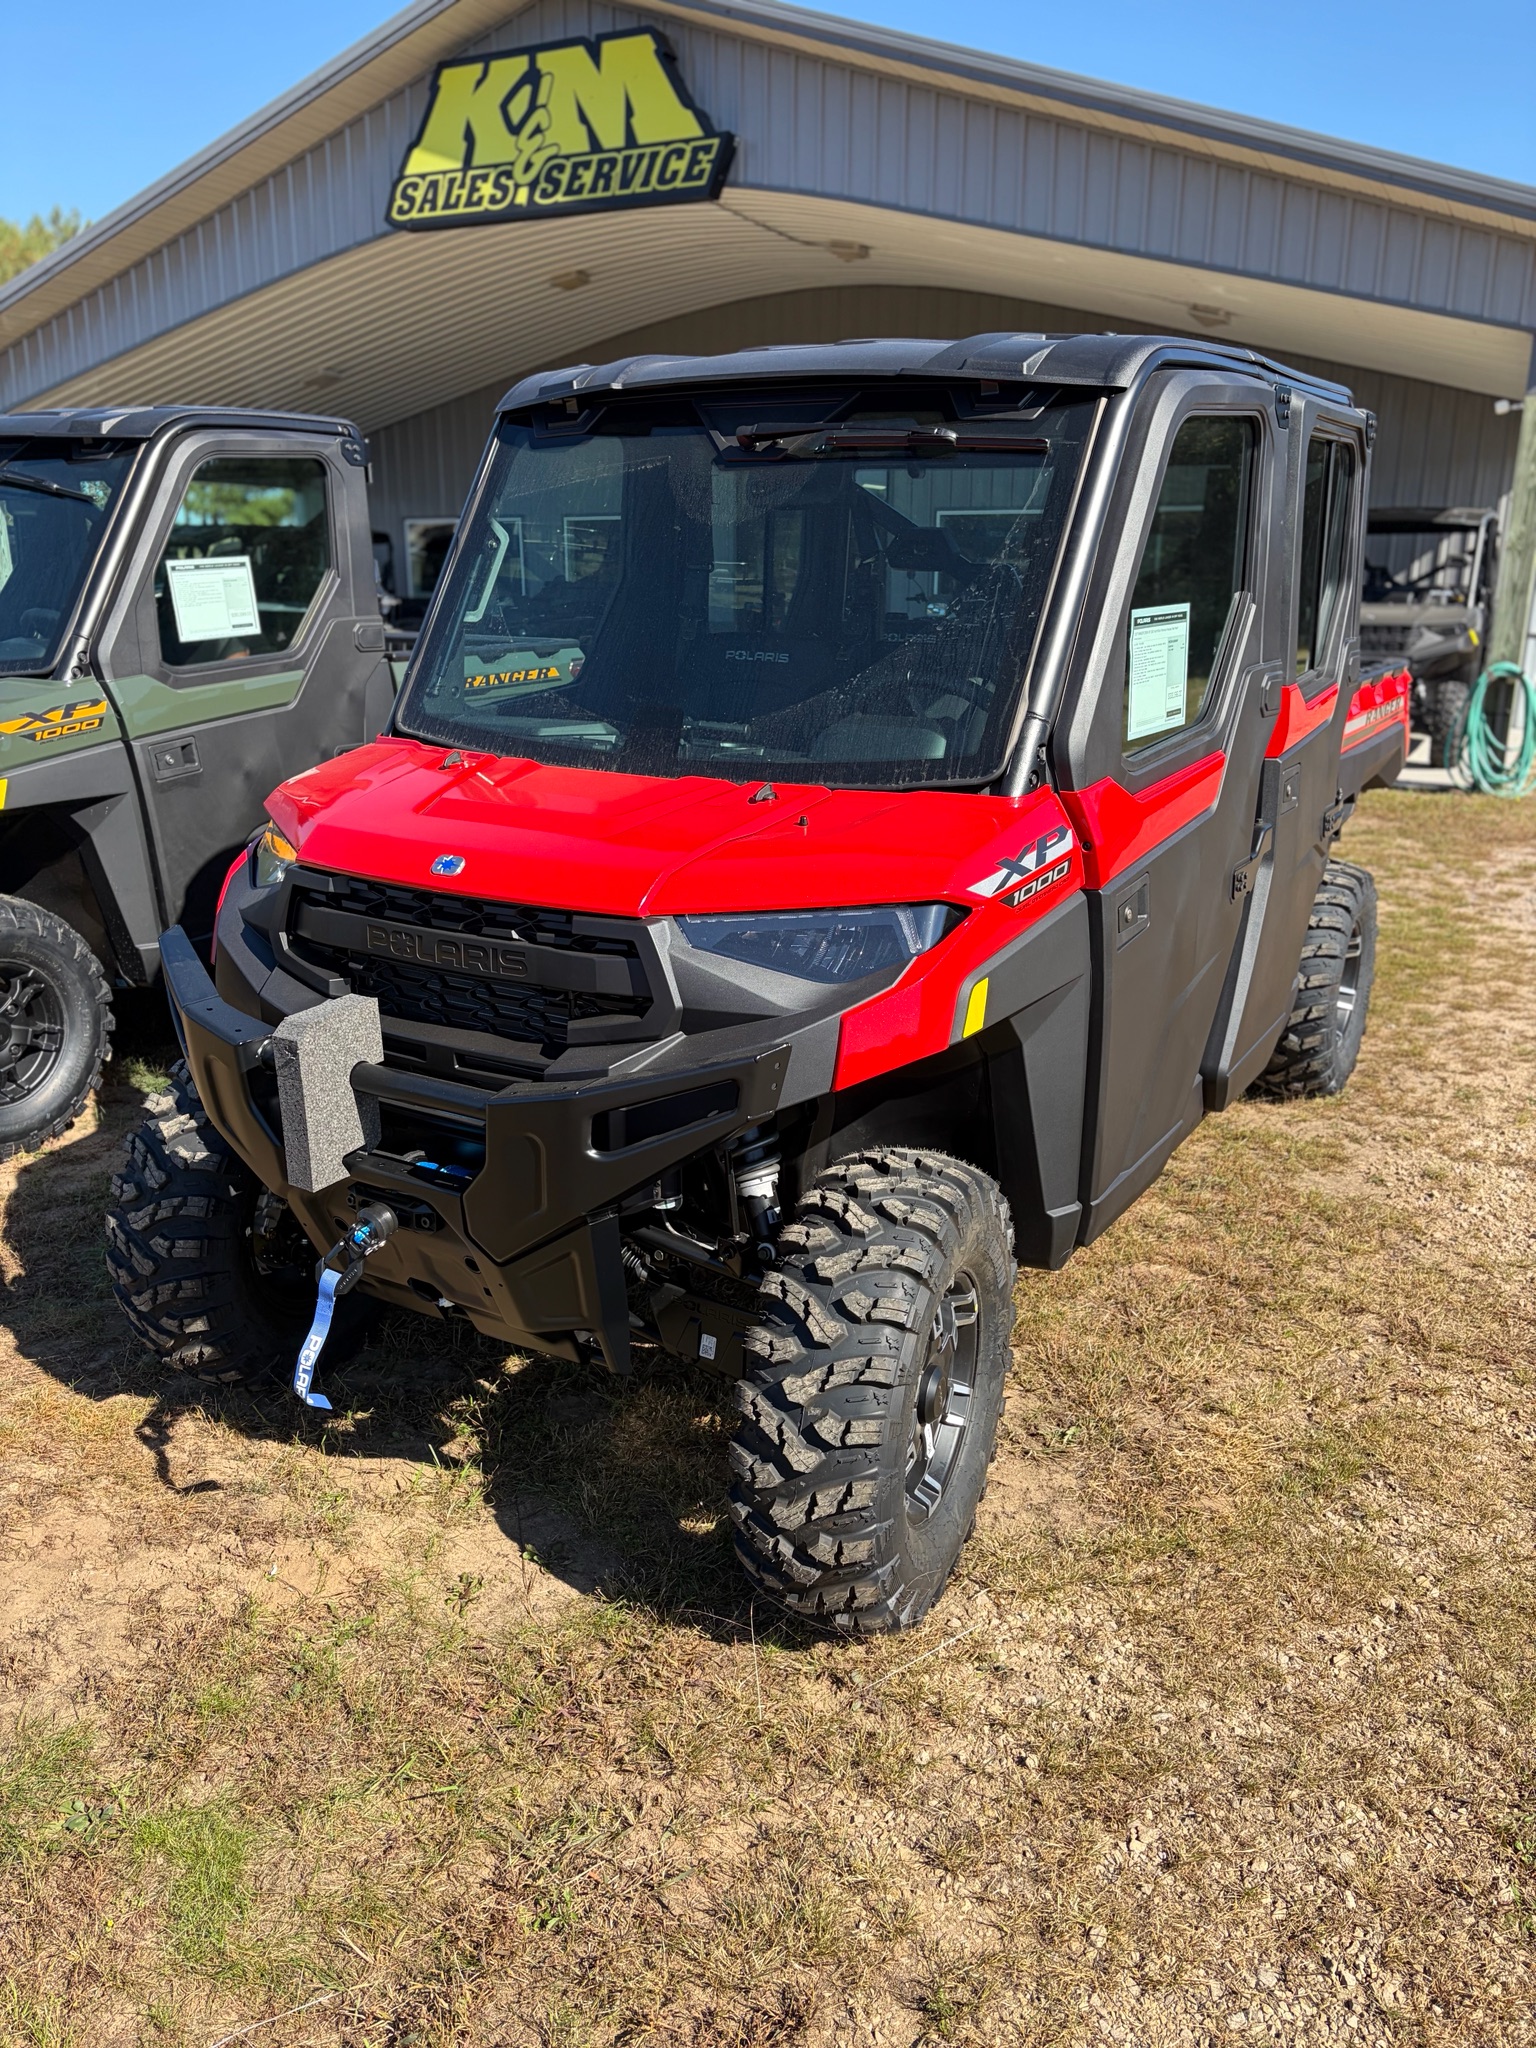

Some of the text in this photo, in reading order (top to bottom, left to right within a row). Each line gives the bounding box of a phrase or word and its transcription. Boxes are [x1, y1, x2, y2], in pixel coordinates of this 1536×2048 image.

[391, 137, 722, 221] SALES SERVICE
[725, 650, 790, 663] POLARIS
[464, 666, 552, 688] RANGER
[12, 698, 103, 732] XP
[1365, 696, 1402, 727] RANGER
[35, 719, 100, 741] 1000
[991, 824, 1069, 895] XP
[1013, 860, 1069, 907] 1000
[366, 924, 528, 977] POLARIS
